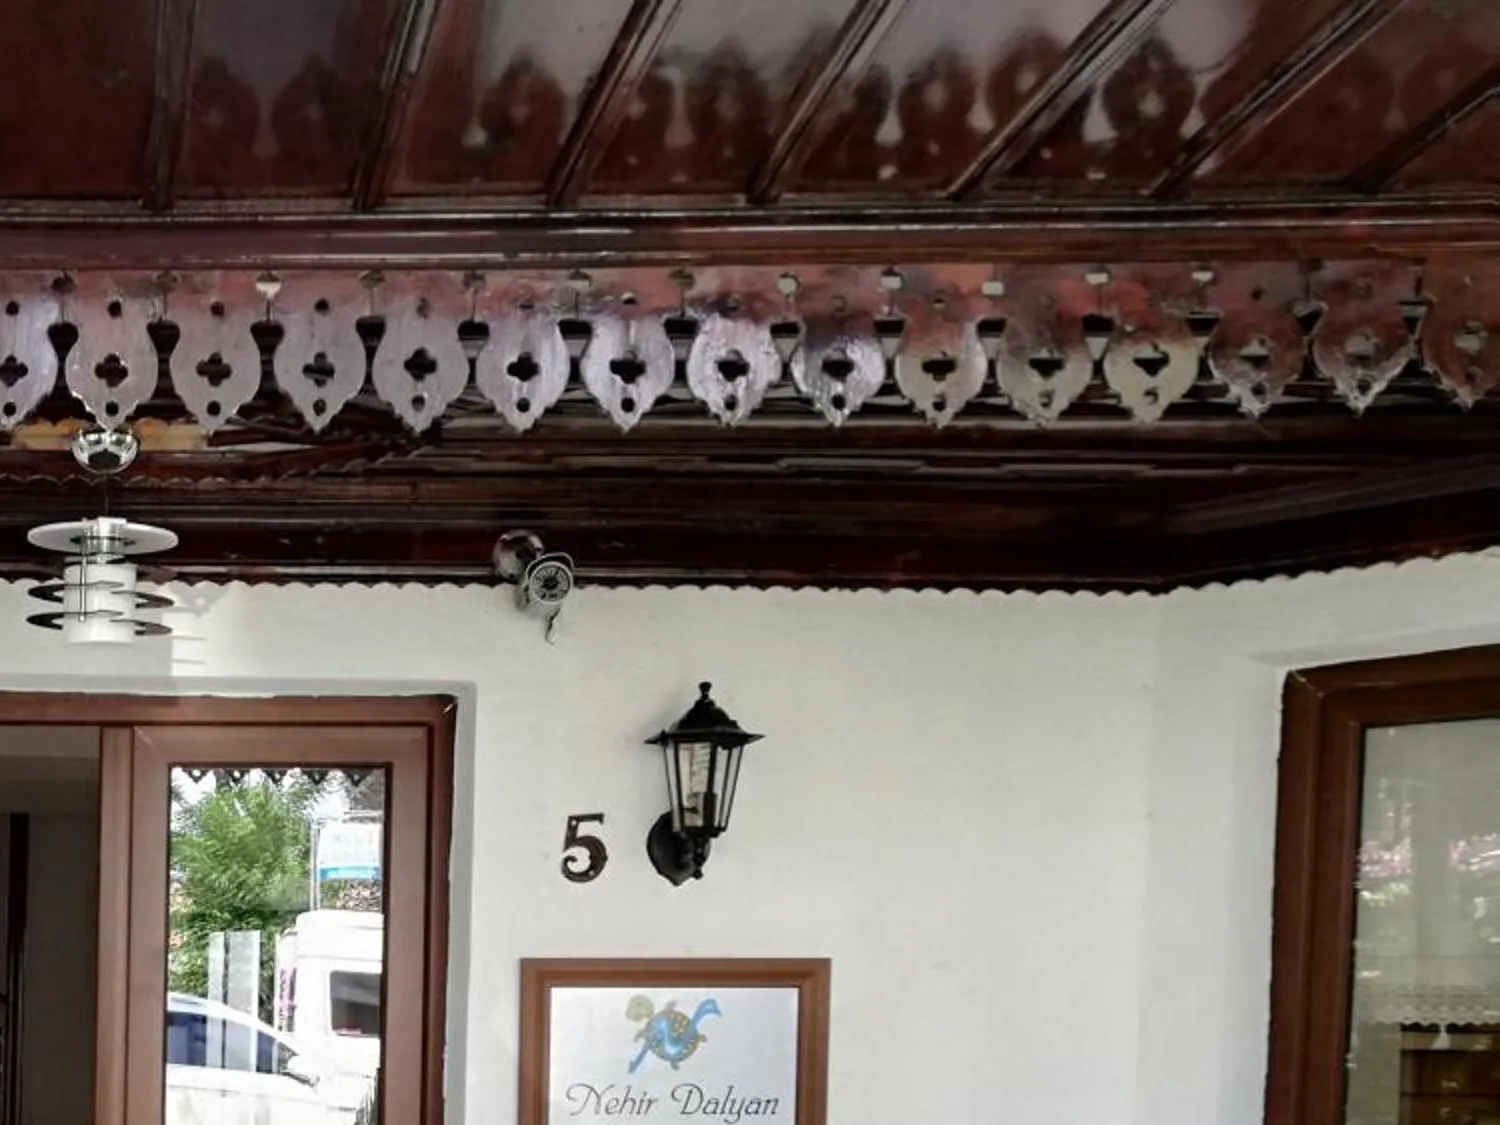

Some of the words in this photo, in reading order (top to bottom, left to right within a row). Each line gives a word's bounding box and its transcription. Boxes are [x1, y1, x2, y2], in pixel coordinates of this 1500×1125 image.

[560, 812, 608, 883] 5
[565, 1082, 659, 1117] Nehir
[670, 1082, 780, 1124] Dalyan
